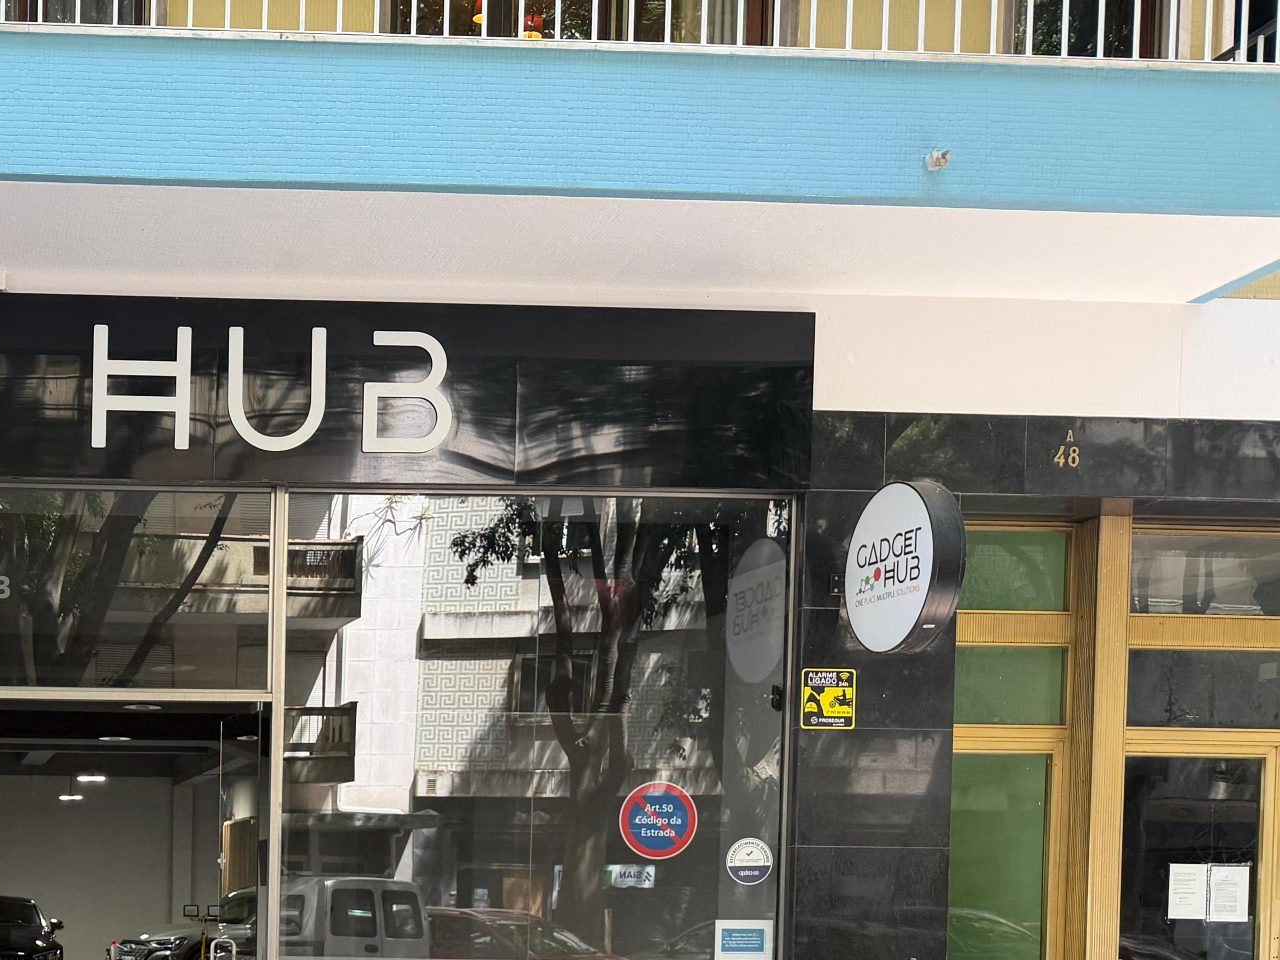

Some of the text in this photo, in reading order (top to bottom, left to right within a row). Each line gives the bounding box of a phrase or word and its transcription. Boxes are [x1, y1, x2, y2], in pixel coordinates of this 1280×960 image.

[91, 324, 452, 453] HUB
[1066, 429, 1074, 442] A
[1053, 445, 1080, 467] 48
[856, 527, 922, 569] GADGET
[883, 555, 921, 588] HUB
[644, 803, 674, 812] Art.50
[636, 815, 682, 826] Código da
[641, 828, 675, 837] Estrada
